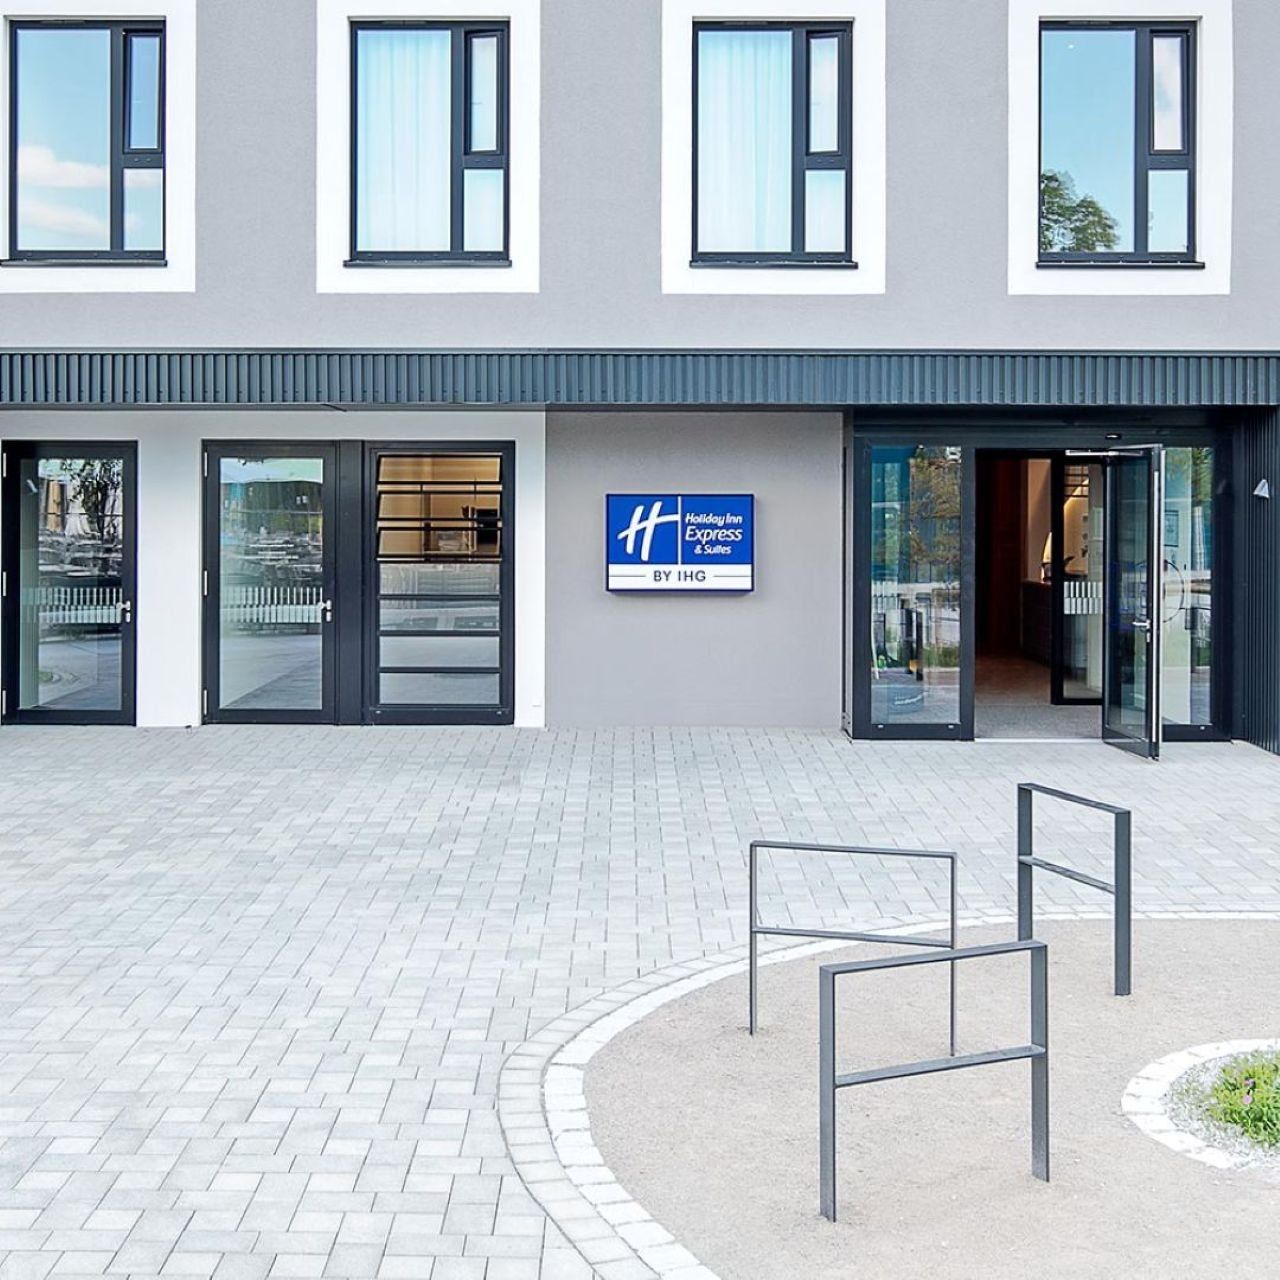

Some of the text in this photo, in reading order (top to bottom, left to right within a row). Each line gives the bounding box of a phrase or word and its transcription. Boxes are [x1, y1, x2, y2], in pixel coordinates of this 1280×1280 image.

[685, 512, 743, 527] Holiday Inn
[685, 526, 744, 545] Express
[693, 544, 732, 555] & Suites
[653, 570, 706, 582] BY IHG
